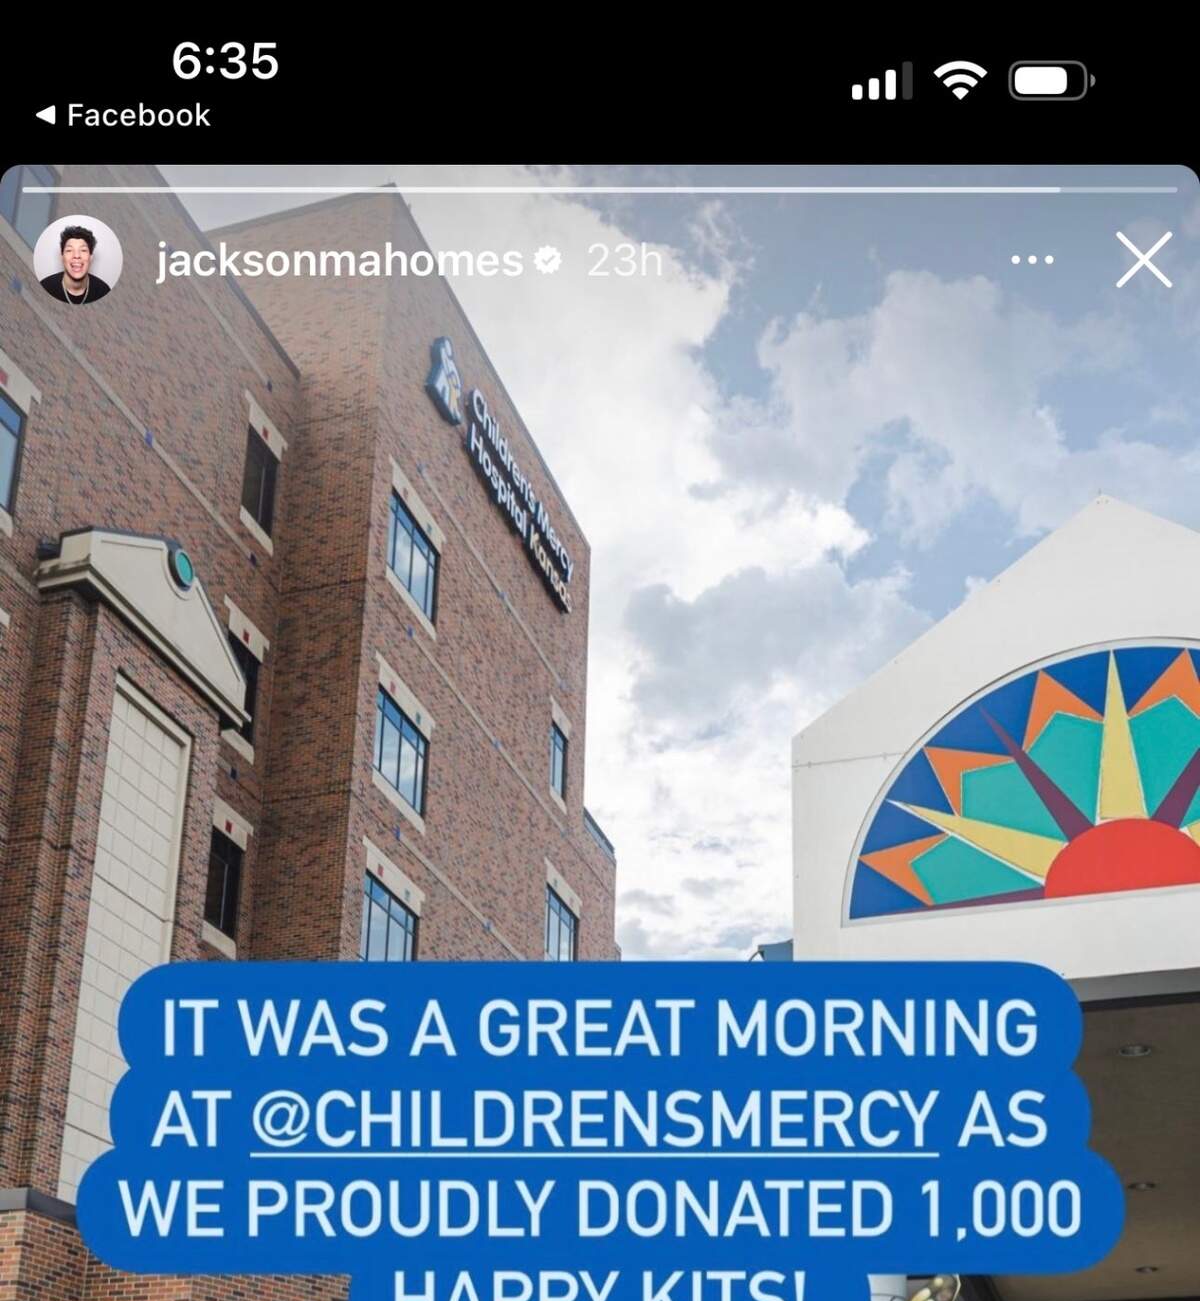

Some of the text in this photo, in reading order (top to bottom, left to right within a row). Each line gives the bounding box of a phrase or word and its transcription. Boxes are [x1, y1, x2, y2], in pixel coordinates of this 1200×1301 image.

[470, 422, 528, 538] Hospital
[472, 387, 574, 584] Children's Mercy
